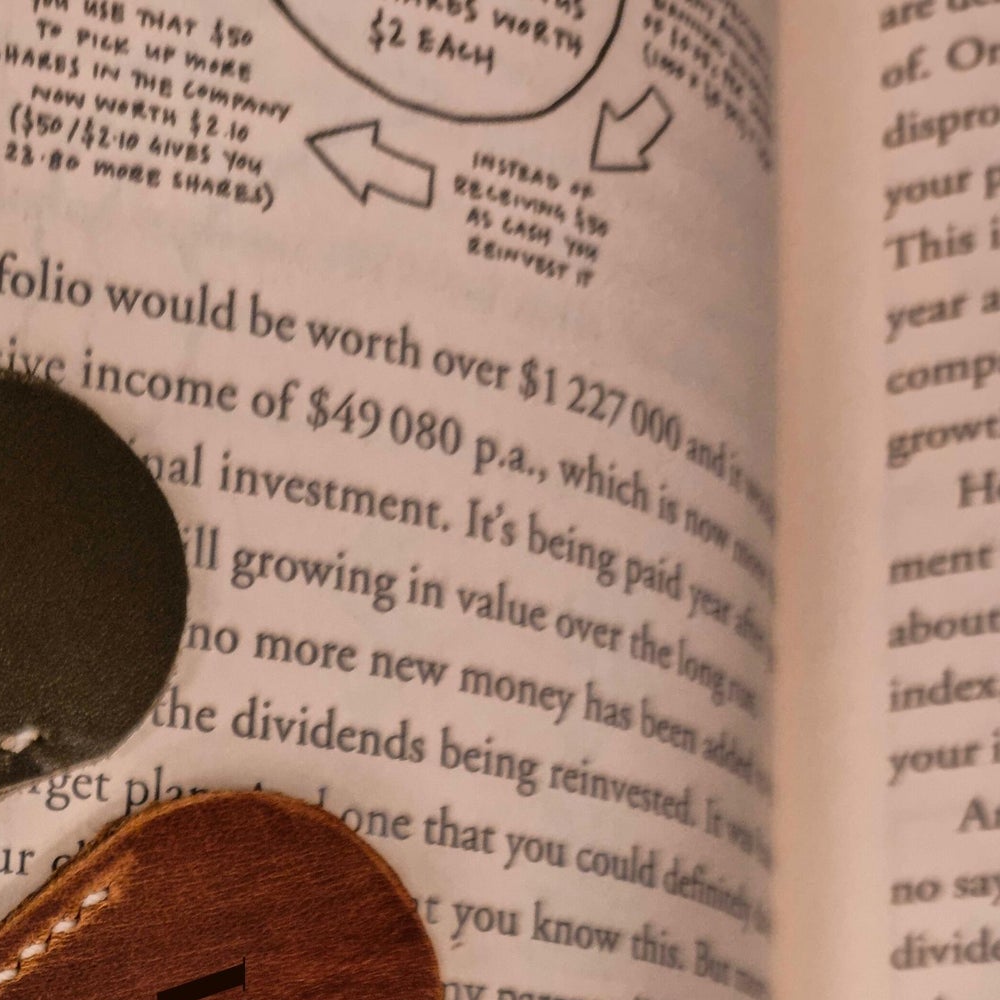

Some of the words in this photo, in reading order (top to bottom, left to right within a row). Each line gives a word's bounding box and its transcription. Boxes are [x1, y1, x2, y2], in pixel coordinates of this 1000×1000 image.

[136, 7, 198, 37] THAT
[369, 7, 407, 53] $2
[416, 26, 496, 75] EACH
[493, 8, 583, 59] WORTH
[37, 17, 63, 40] TO
[76, 27, 130, 56] PICK
[145, 44, 177, 64] UP
[185, 51, 251, 84] MORE
[880, 45, 931, 92] of.
[30, 84, 86, 111] NOW
[93, 93, 177, 128] WORTH
[92, 61, 121, 82] IN
[131, 68, 173, 99] THE
[182, 80, 293, 124] COMPANY
[148, 135, 211, 165] GIVES
[223, 148, 263, 177] YOU
[472, 150, 560, 192] INSTEAD
[93, 158, 162, 189] MORE
[172, 170, 275, 214] SHARES)
[454, 173, 566, 225] RECEIVING
[883, 164, 973, 223] your
[465, 206, 493, 230] AS
[501, 215, 552, 248] CASH
[883, 222, 977, 271] This
[467, 235, 570, 280] REINVEST
[105, 283, 239, 332] would
[250, 293, 296, 342] be
[306, 322, 421, 369] worth
[433, 347, 511, 391] over
[884, 292, 967, 345] year
[82, 348, 239, 413] income
[251, 379, 302, 423] of
[473, 435, 548, 485] p.a.,
[558, 453, 650, 514] which
[657, 483, 678, 525] is
[886, 411, 1000, 470] growt
[128, 433, 205, 488] nal
[219, 452, 450, 532] investment.
[528, 513, 617, 586] being
[623, 555, 682, 601] paid
[889, 541, 994, 586] ment
[180, 523, 220, 571] ill
[230, 547, 397, 612] growing
[407, 566, 446, 610] in
[456, 580, 547, 633] value
[554, 612, 623, 652] over
[629, 622, 673, 671] the
[187, 620, 239, 655] no
[252, 629, 357, 673] more
[368, 648, 449, 688] new
[458, 664, 576, 727] money
[584, 681, 632, 731] has
[640, 698, 697, 755] been
[151, 685, 217, 734] the
[231, 696, 426, 763] dividends
[440, 726, 541, 797] being
[549, 759, 697, 828] reinvested.
[887, 736, 982, 788] your
[29, 769, 111, 812] get
[125, 764, 209, 817] pla
[342, 805, 414, 842] one
[423, 804, 497, 855] that
[504, 830, 566, 871] you
[576, 844, 656, 889] could
[890, 875, 942, 907] no
[450, 898, 518, 940] you
[530, 899, 621, 953] know
[631, 921, 686, 972] this.
